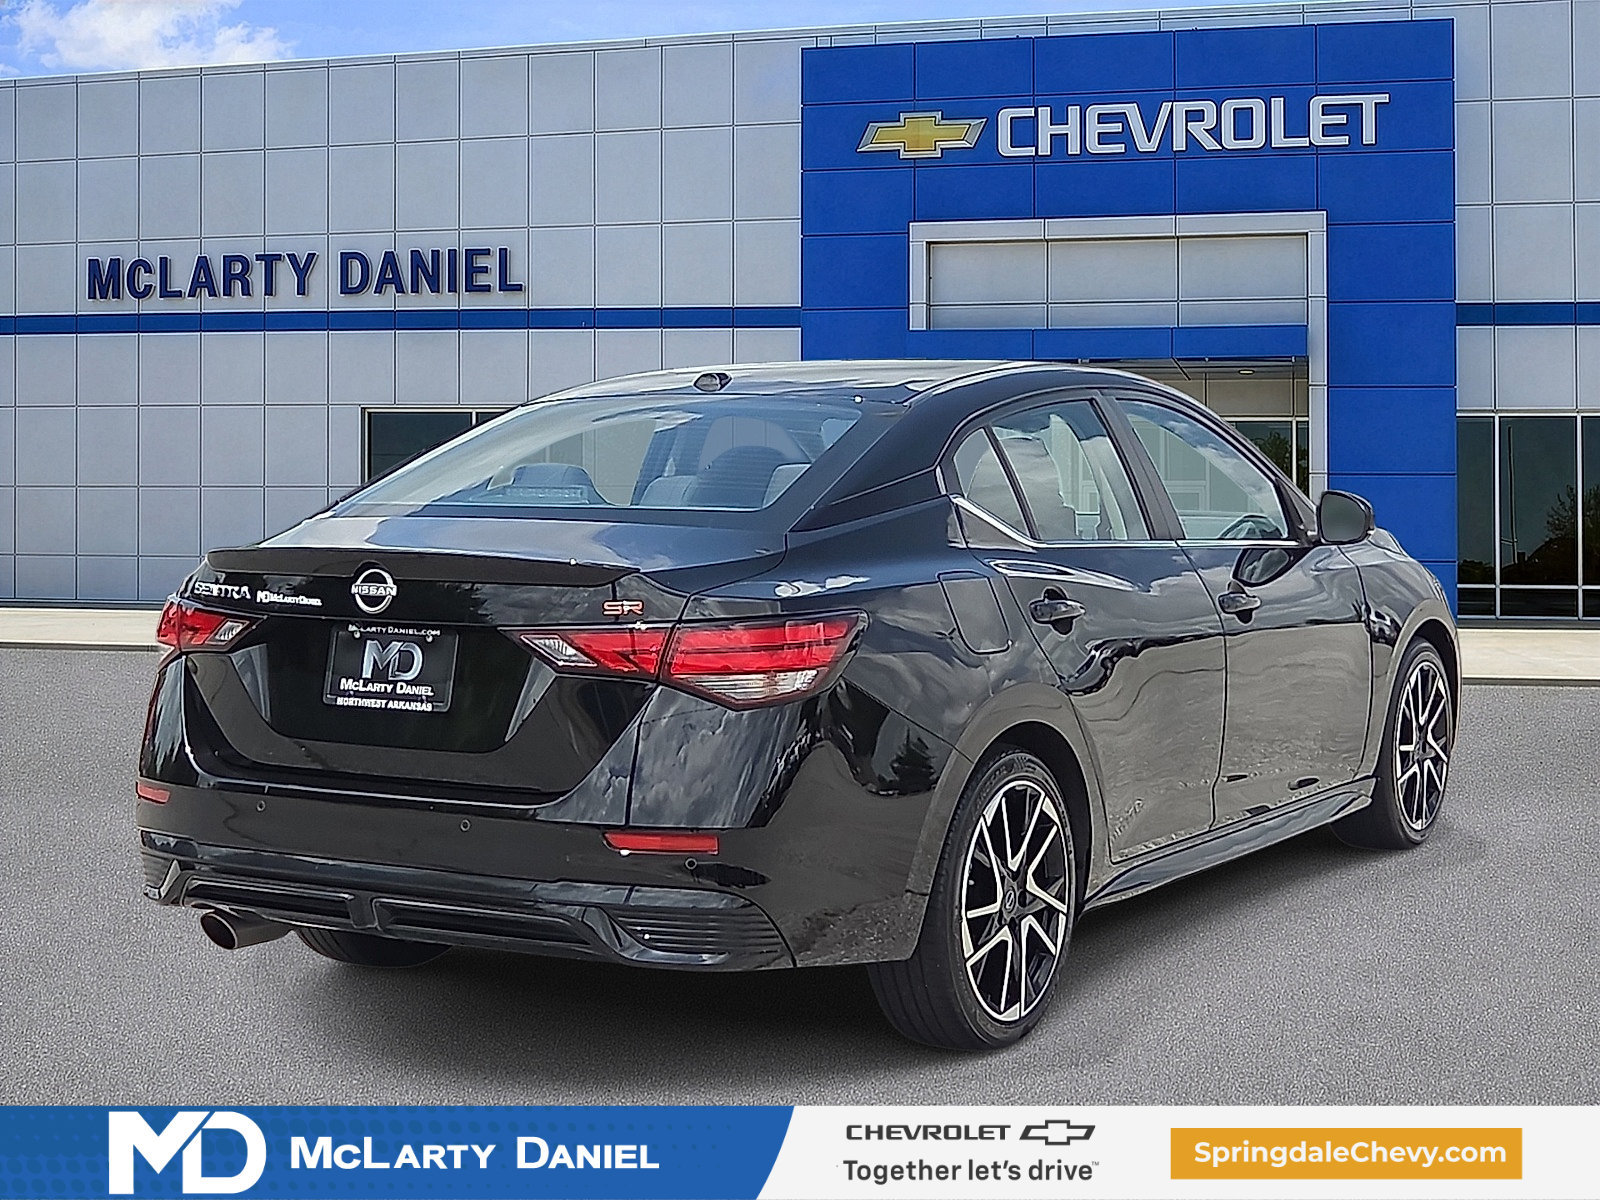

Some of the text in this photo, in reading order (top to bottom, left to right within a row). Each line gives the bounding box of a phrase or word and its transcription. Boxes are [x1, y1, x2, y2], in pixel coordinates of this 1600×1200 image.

[997, 93, 1390, 158] CHEVROLET
[87, 247, 525, 300] MCLARTY DANIEL
[351, 583, 397, 596] NISSAN
[603, 600, 643, 615] SR
[361, 639, 423, 681] MD
